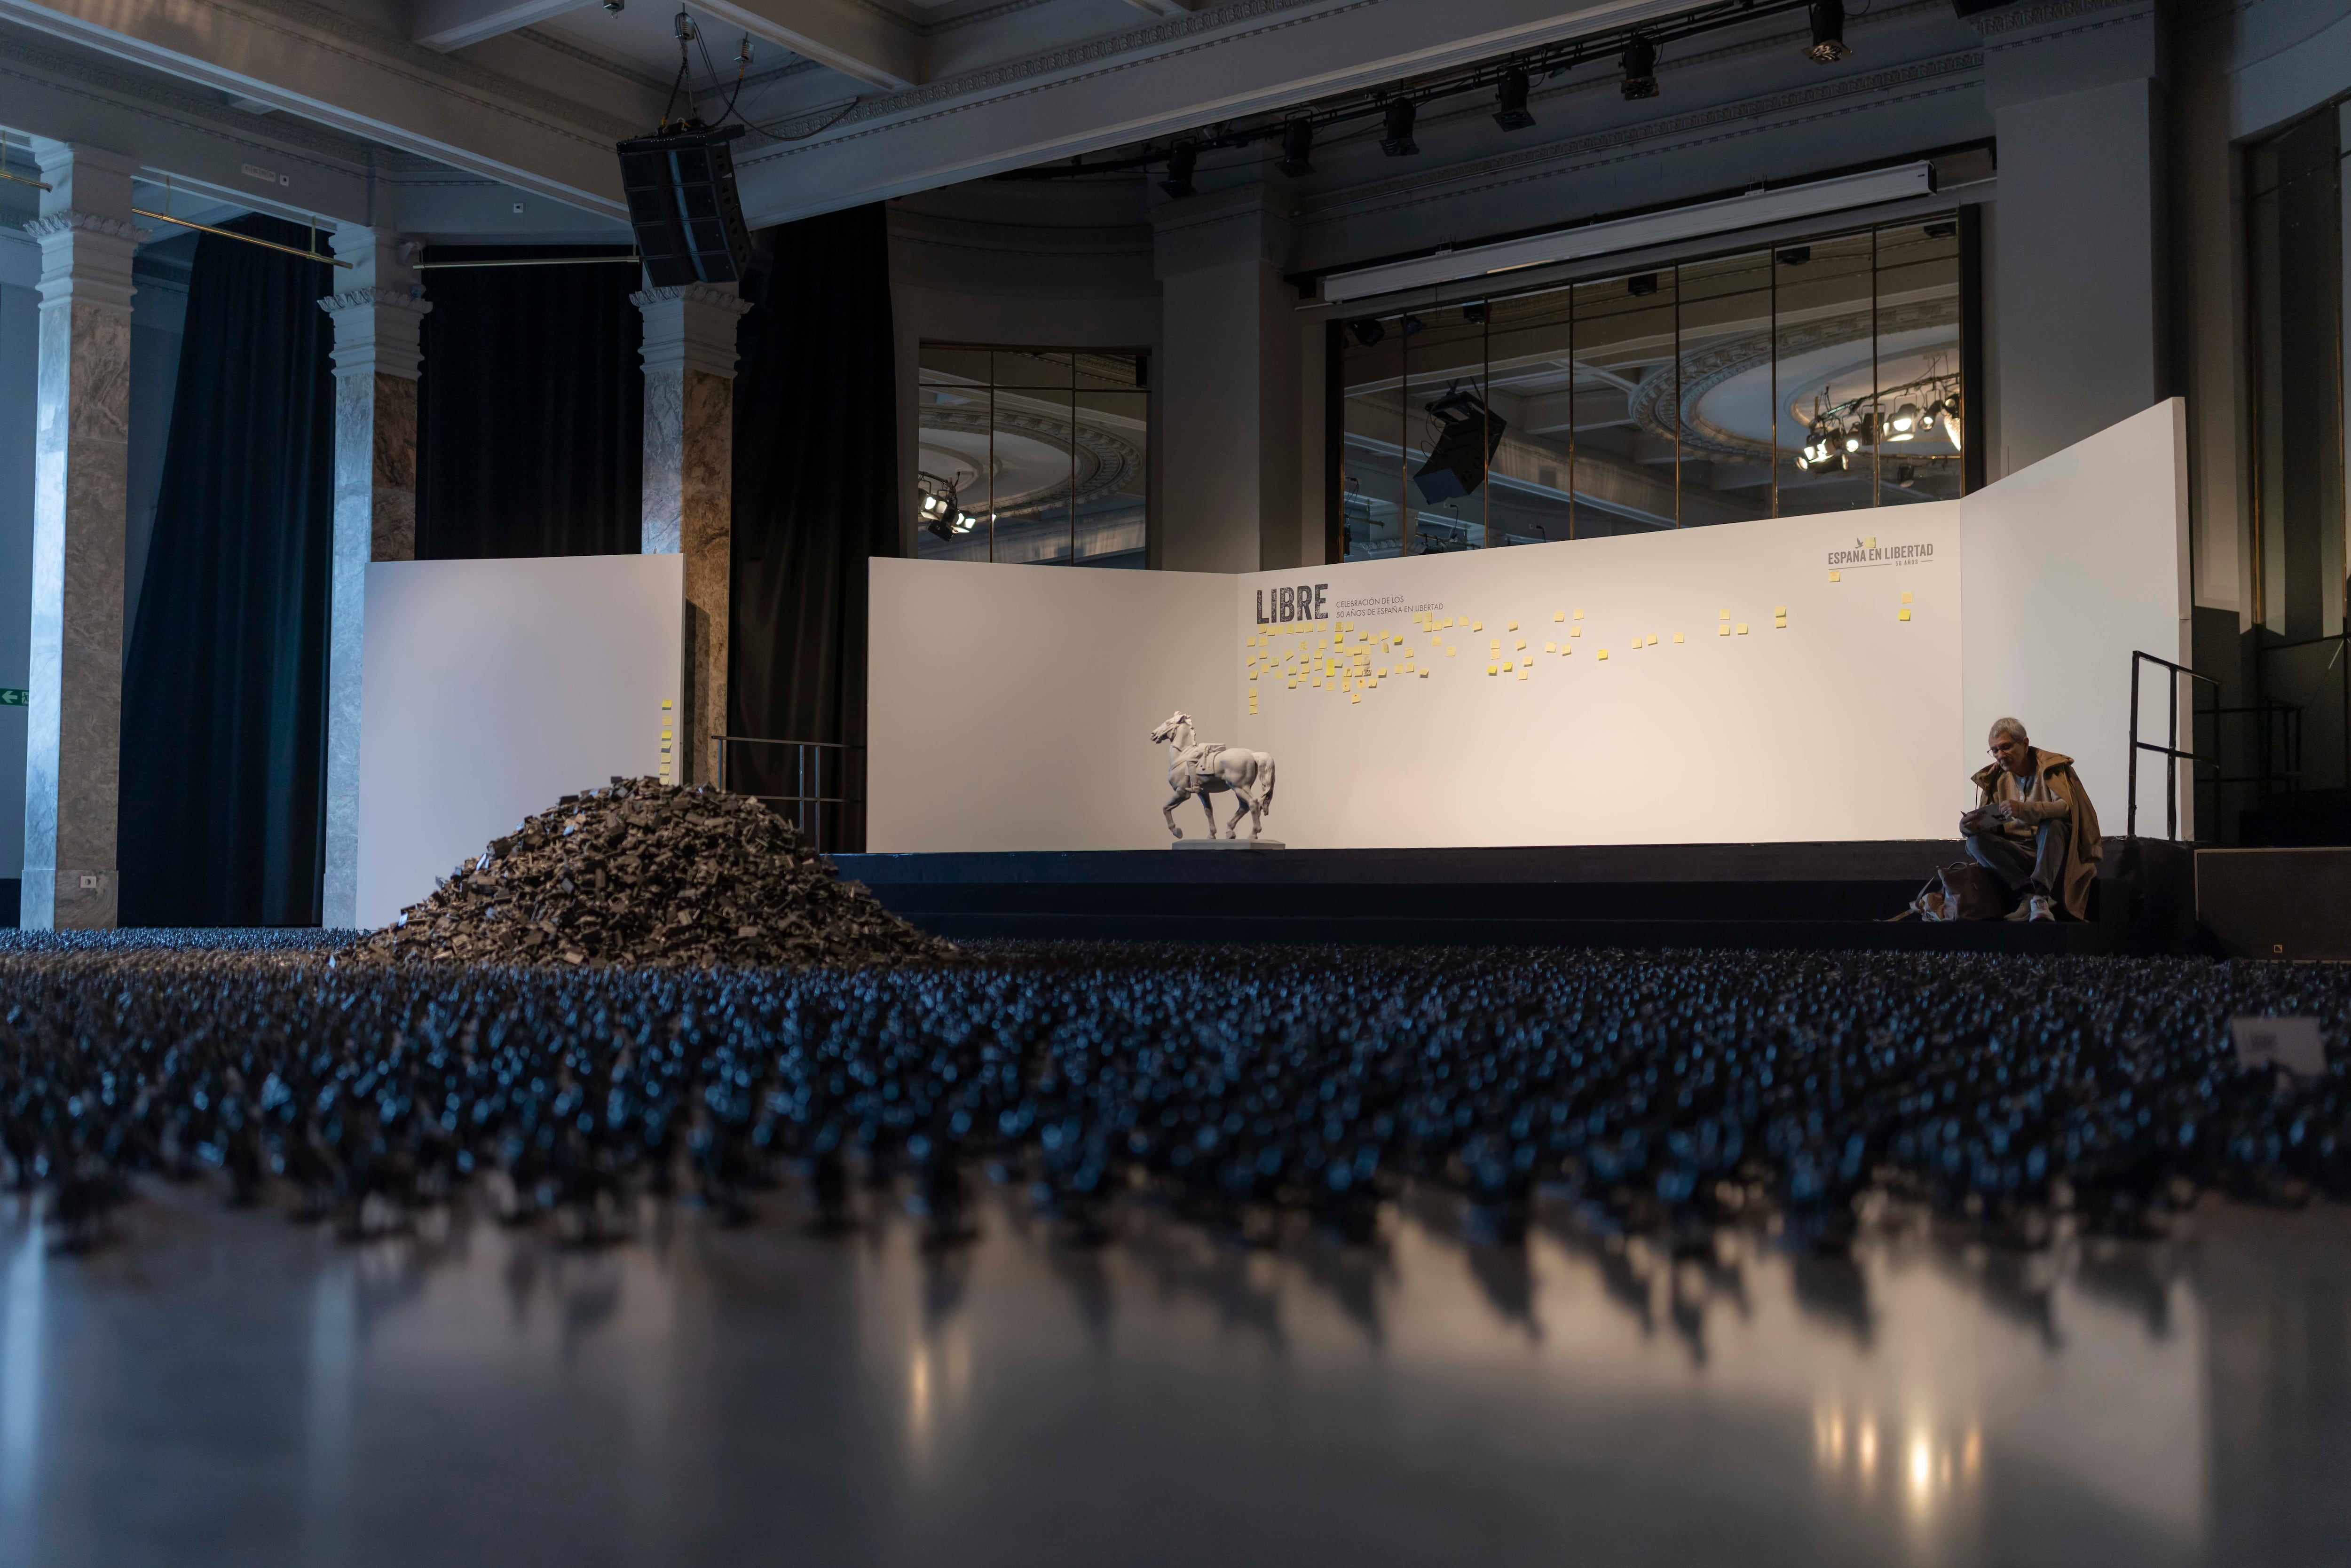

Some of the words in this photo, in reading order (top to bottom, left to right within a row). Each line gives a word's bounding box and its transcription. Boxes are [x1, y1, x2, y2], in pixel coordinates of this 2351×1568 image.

[1869, 548, 1882, 561] EN
[1885, 544, 1933, 559] LIBERTAD
[1257, 583, 1328, 624] LIBRE
[1336, 597, 1380, 608] CELEBRACIÓN
[1346, 609, 1365, 617] AÑOS
[1377, 606, 1402, 615] ESPAÑA
[1415, 603, 1444, 612] LIBERTAD
